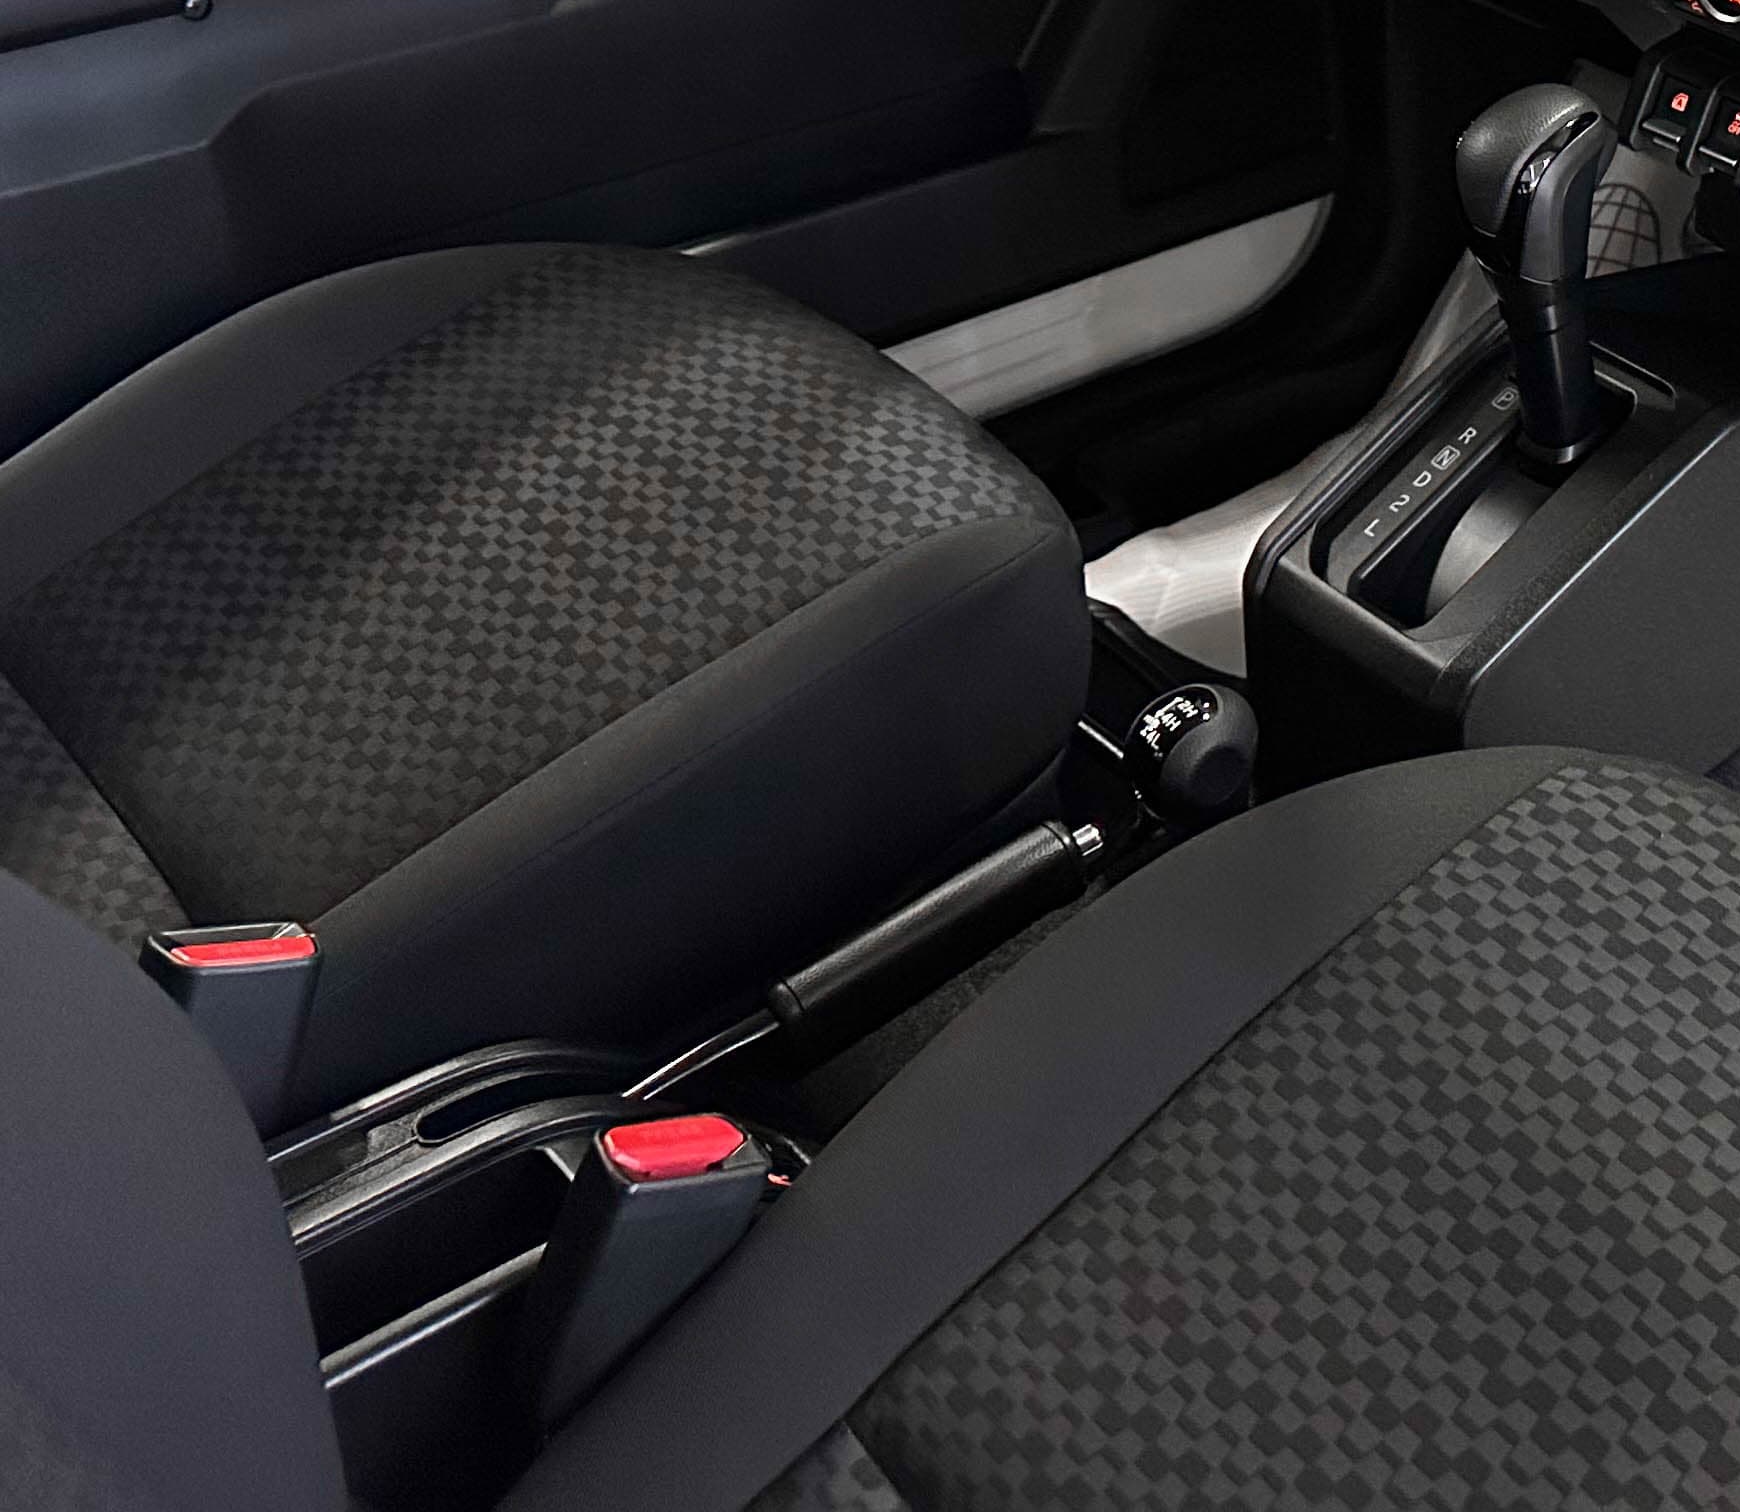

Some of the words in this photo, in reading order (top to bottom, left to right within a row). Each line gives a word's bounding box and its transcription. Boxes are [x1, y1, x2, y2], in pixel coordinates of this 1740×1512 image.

[1458, 426, 1477, 444] R
[1412, 470, 1432, 488] D
[1388, 493, 1410, 513] 2
[1363, 518, 1380, 537] L
